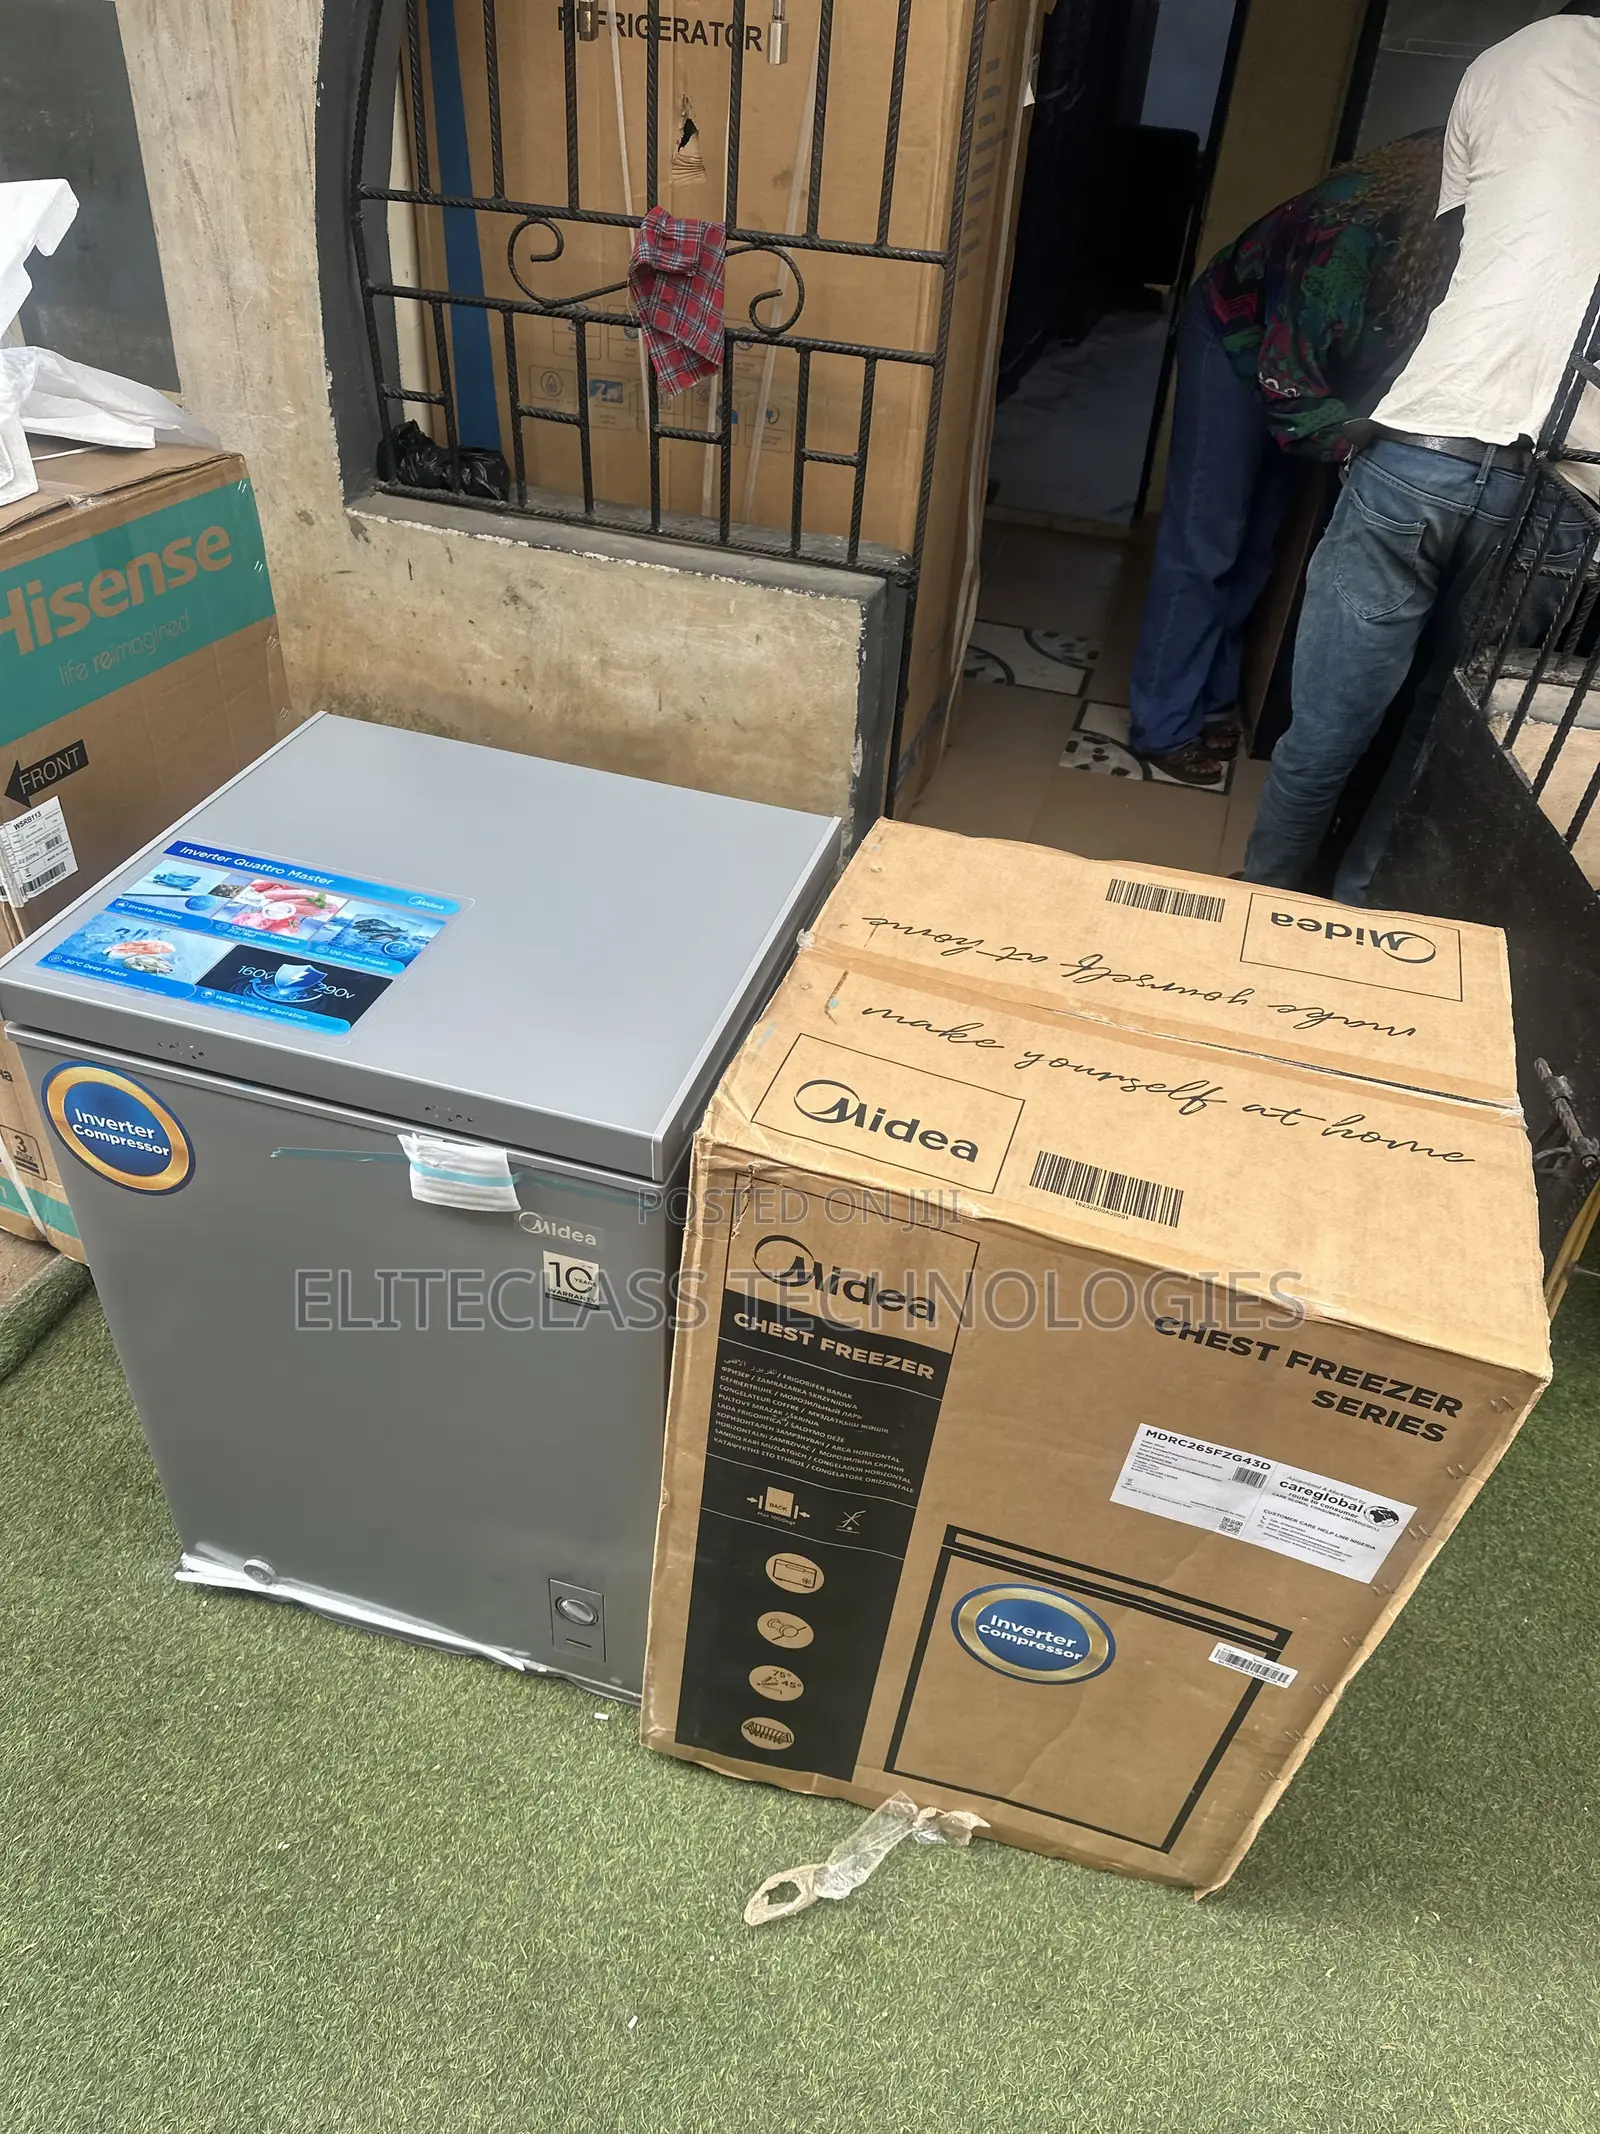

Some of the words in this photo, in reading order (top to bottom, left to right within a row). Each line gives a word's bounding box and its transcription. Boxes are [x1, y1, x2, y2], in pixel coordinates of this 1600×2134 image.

[557, 6, 763, 51] FRIGERATOR
[0, 525, 232, 656] Hisense
[58, 659, 89, 688] life
[92, 609, 190, 675] reimagined
[19, 746, 79, 795] FRONT
[14, 811, 42, 830] WSRB113
[180, 846, 233, 863] Inverter
[234, 858, 286, 875] Quattro
[287, 869, 335, 886] Master
[127, 903, 155, 914] Inverter
[156, 909, 183, 920] Quattro
[408, 896, 446, 911] Midea
[269, 933, 301, 945] between
[862, 916, 985, 957] home
[1271, 911, 1437, 964] Midea
[976, 946, 1048, 962] at
[1060, 953, 1256, 1006] yourself
[270, 1006, 309, 1022] Operation
[1268, 1004, 1417, 1038] make
[862, 1006, 1005, 1049] make
[1014, 1050, 1228, 1116] yourself
[1242, 1103, 1327, 1126] at
[1321, 1114, 1475, 1163] home
[74, 1108, 155, 1141] Inverter
[795, 1078, 980, 1165] Midea
[14, 1134, 28, 1153] 3
[72, 1124, 170, 1156] Compressor
[518, 1210, 598, 1247] Midea
[573, 1277, 597, 1288] YEARS
[752, 1234, 937, 1323] Midea
[547, 1287, 597, 1304] WARRANTY
[733, 1311, 815, 1347] CHEST
[820, 1336, 936, 1381] FREEZER
[1153, 1315, 1281, 1363] CHEST
[1285, 1349, 1464, 1418] FREEZER
[719, 1384, 771, 1403] CONGELATEUR
[772, 1399, 800, 1412] COFFRE
[720, 1375, 772, 1395] GEFRIERTRUHE
[757, 1376, 807, 1395] ZAMRAZARKA
[808, 1391, 858, 1410] SKRZYNIOWA
[715, 1420, 768, 1440] HORIZONTALNI
[1311, 1389, 1448, 1444] SERIES
[831, 1444, 852, 1454] ARCA
[852, 1449, 901, 1464] HORIZONTAL
[1145, 1428, 1272, 1471] MDRC265FZG43D
[811, 1465, 863, 1482] CONGELATORE
[864, 1477, 915, 1494] ORIZZONTALE
[813, 1457, 863, 1474] CONGELADOR
[864, 1468, 911, 1484] HORIZONTAL
[1287, 1475, 1322, 1490] Assembled
[769, 1502, 788, 1512] BACK
[1279, 1480, 1364, 1513] careglobal
[1288, 1492, 1309, 1502] route
[1310, 1498, 1319, 1506] to
[1320, 1503, 1360, 1519] consumer
[1263, 1508, 1298, 1524] CUSTOMER
[1298, 1519, 1316, 1530] CARE
[1317, 1525, 1334, 1536] HELP
[1334, 1532, 1349, 1542] LINE
[1350, 1538, 1377, 1551] NIGERIA
[978, 1624, 1083, 1660] Compressor
[990, 1614, 1077, 1648] Inverter
